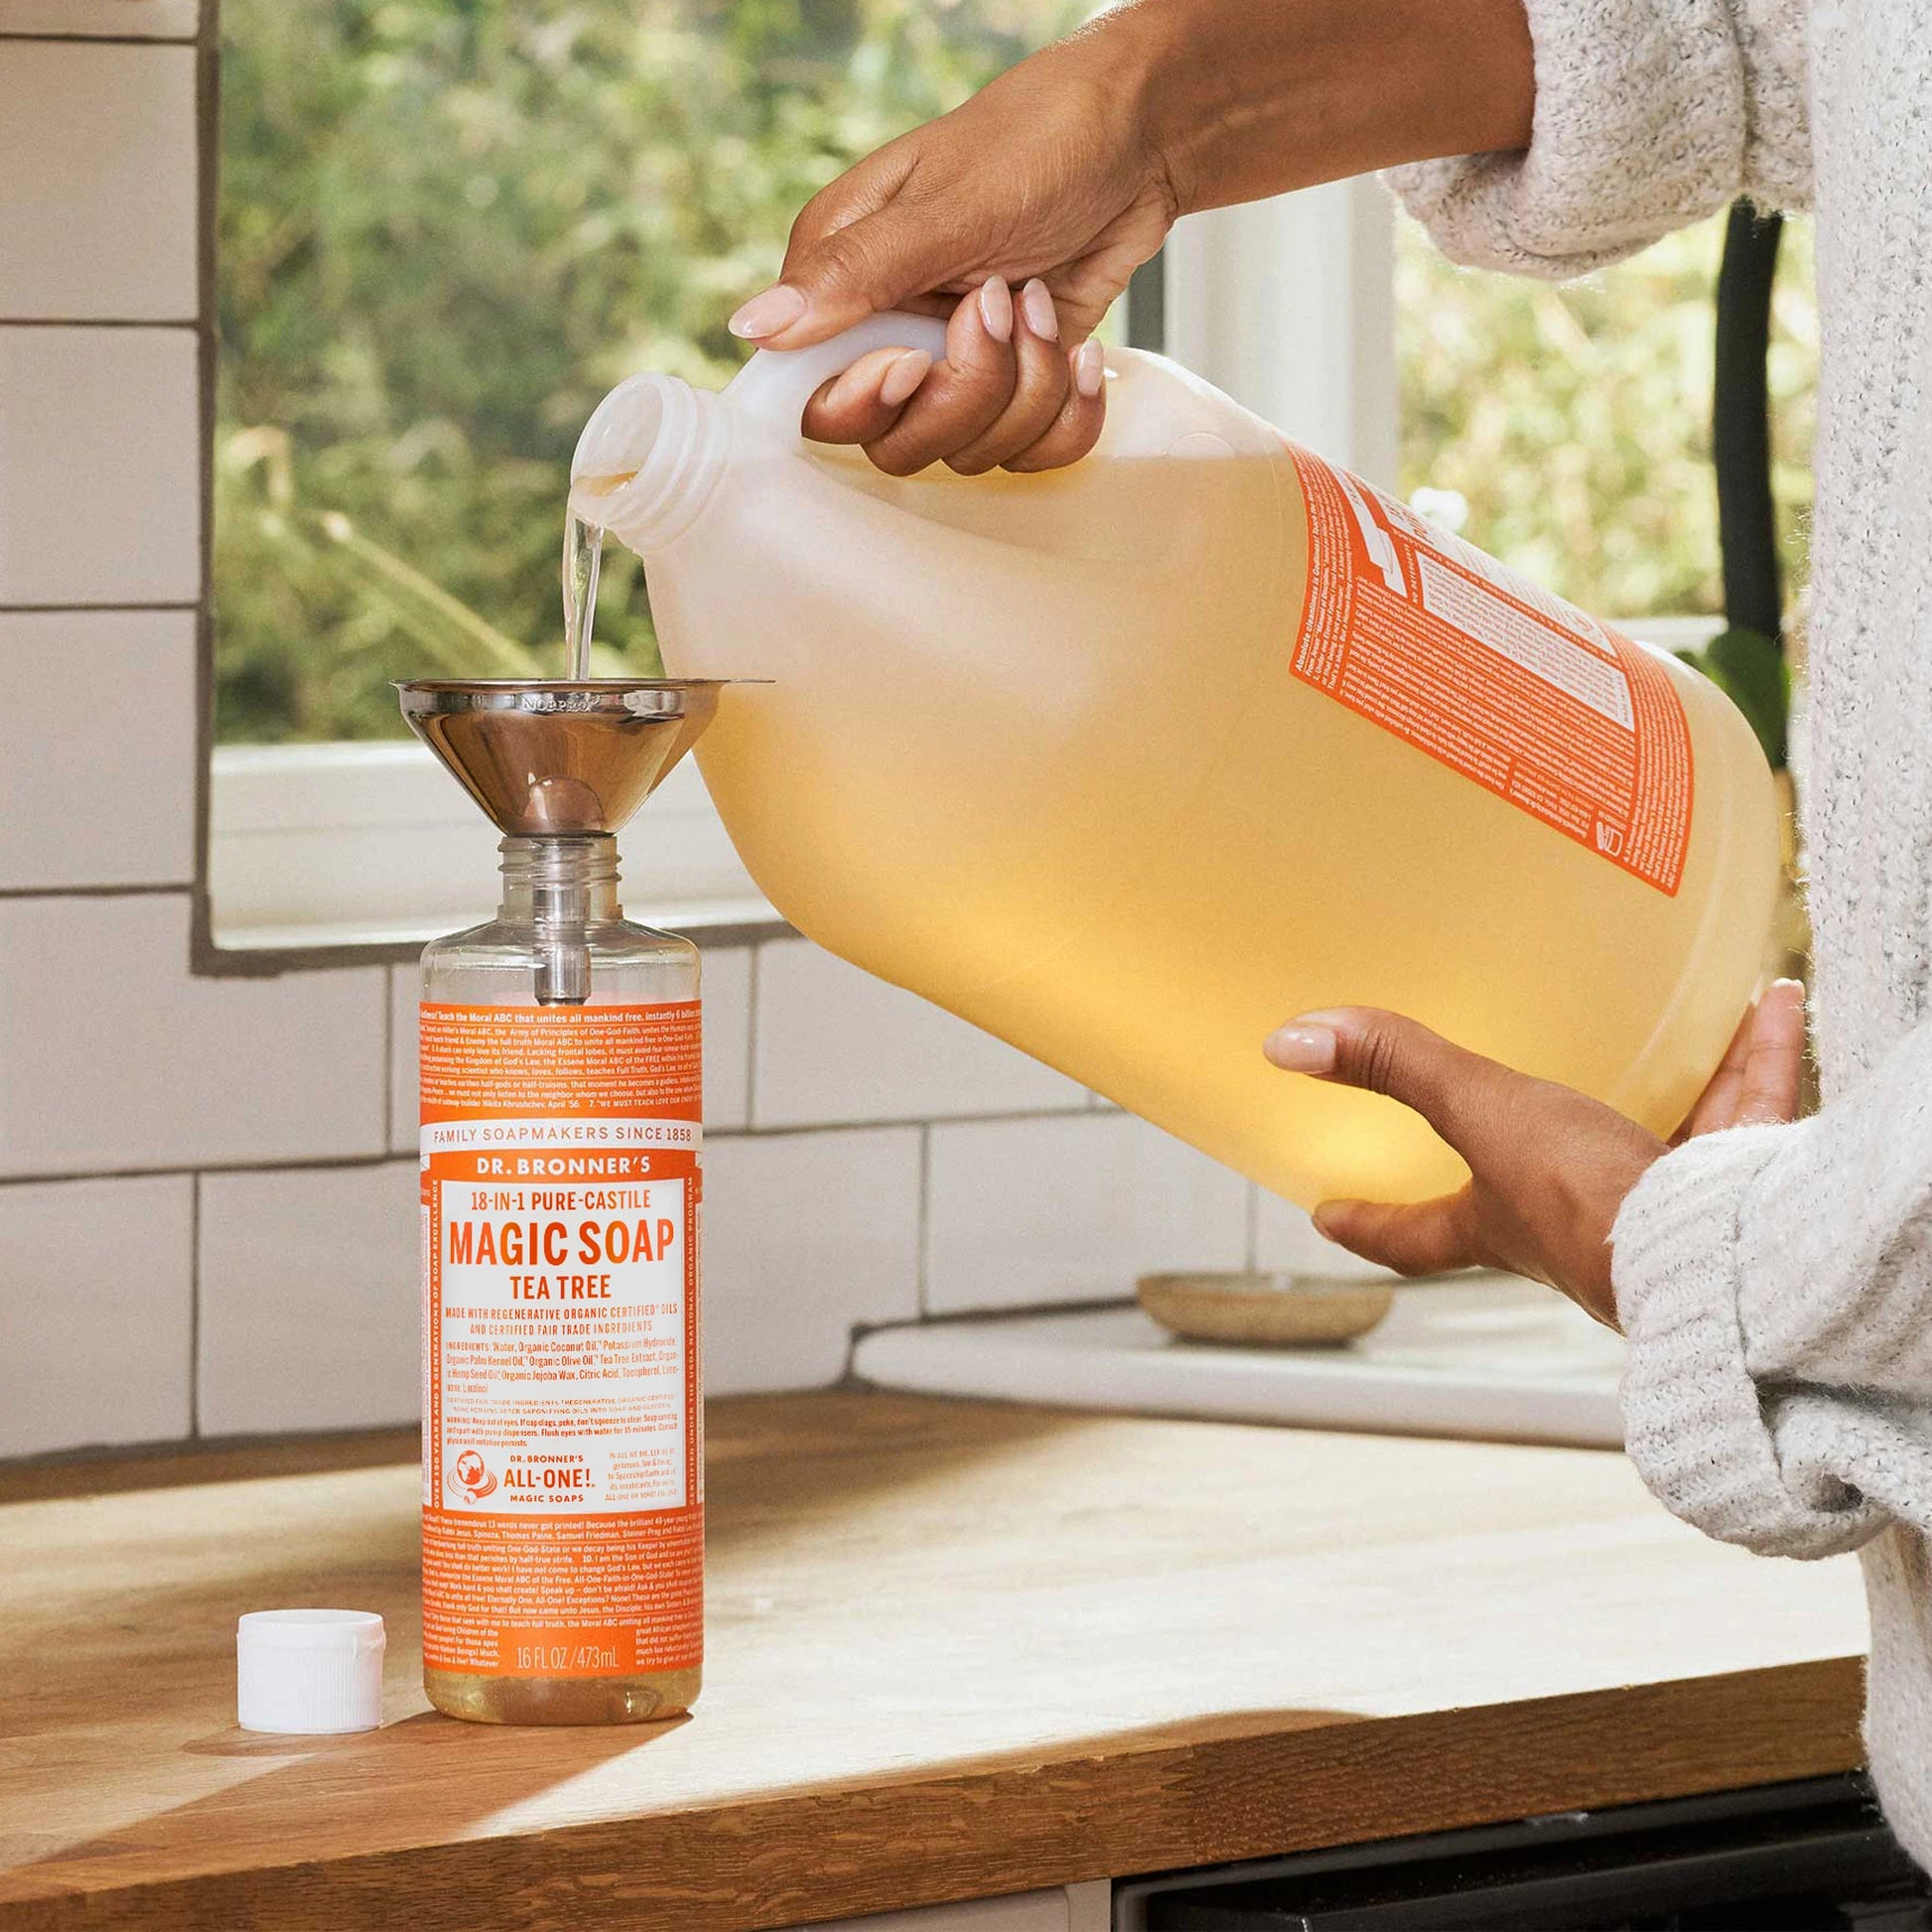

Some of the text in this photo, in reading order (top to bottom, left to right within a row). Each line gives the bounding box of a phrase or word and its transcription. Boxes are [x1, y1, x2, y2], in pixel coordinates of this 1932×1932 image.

[1295, 632, 1311, 672] Absolute
[1306, 586, 1318, 631] cleanliness
[457, 1012, 467, 1021] the
[470, 1013, 491, 1023] Moral
[494, 1014, 512, 1023] ABC
[515, 1014, 534, 1023] that
[537, 1014, 566, 1023] unites
[570, 1014, 581, 1023] all
[584, 1013, 622, 1023] mankind
[510, 1029, 528, 1037] Army
[540, 1028, 578, 1037] Principles
[616, 1035, 643, 1044] mankind
[527, 1048, 556, 1057] Lacking
[541, 1091, 573, 1100] neighbor
[434, 1127, 692, 1144] FAMILY SOAPMAKERS SINCE 1858
[477, 1156, 651, 1175] DR. BRONNER'S
[471, 1189, 651, 1210] 18-IN-1 PURE-CASTILE
[450, 1218, 674, 1266] MAGIC SOAP
[432, 1285, 439, 1299] OF
[509, 1274, 612, 1300] TEA TREE
[445, 1307, 466, 1318] MADE
[468, 1308, 488, 1319] WITH
[490, 1309, 561, 1320] REGENERATIVE
[563, 1308, 608, 1319] ORGANIC
[661, 1304, 678, 1314] OILS
[470, 1320, 652, 1335] AND CERTIFIED FAIR TRADE INGREDIENTS
[492, 1341, 516, 1352] Water,
[518, 1341, 549, 1354] Organic
[550, 1341, 584, 1352] Coconut
[470, 1354, 486, 1365] Palm
[487, 1355, 511, 1366] Kernel
[561, 1355, 581, 1366] Olive
[600, 1354, 613, 1364] Tea
[614, 1353, 629, 1364] Tree
[452, 1369, 469, 1381] Hemp
[470, 1369, 487, 1380] Seed
[501, 1370, 532, 1381] Organic
[532, 1370, 557, 1382] Jojoba
[558, 1371, 578, 1381] Wax,
[579, 1369, 601, 1380] Citric
[577, 1428, 593, 1437] with
[509, 1454, 584, 1463] DR. BRONNER'S
[509, 1494, 584, 1503] MAGIC SOAPS
[586, 1520, 616, 1529] Because
[584, 1545, 605, 1554] decay
[580, 1565, 605, 1575] change
[636, 1636, 648, 1645] that
[470, 1658, 499, 1667] Whatever
[517, 1646, 532, 1669] 16
[534, 1646, 548, 1669] FL
[550, 1646, 568, 1669] OZ
